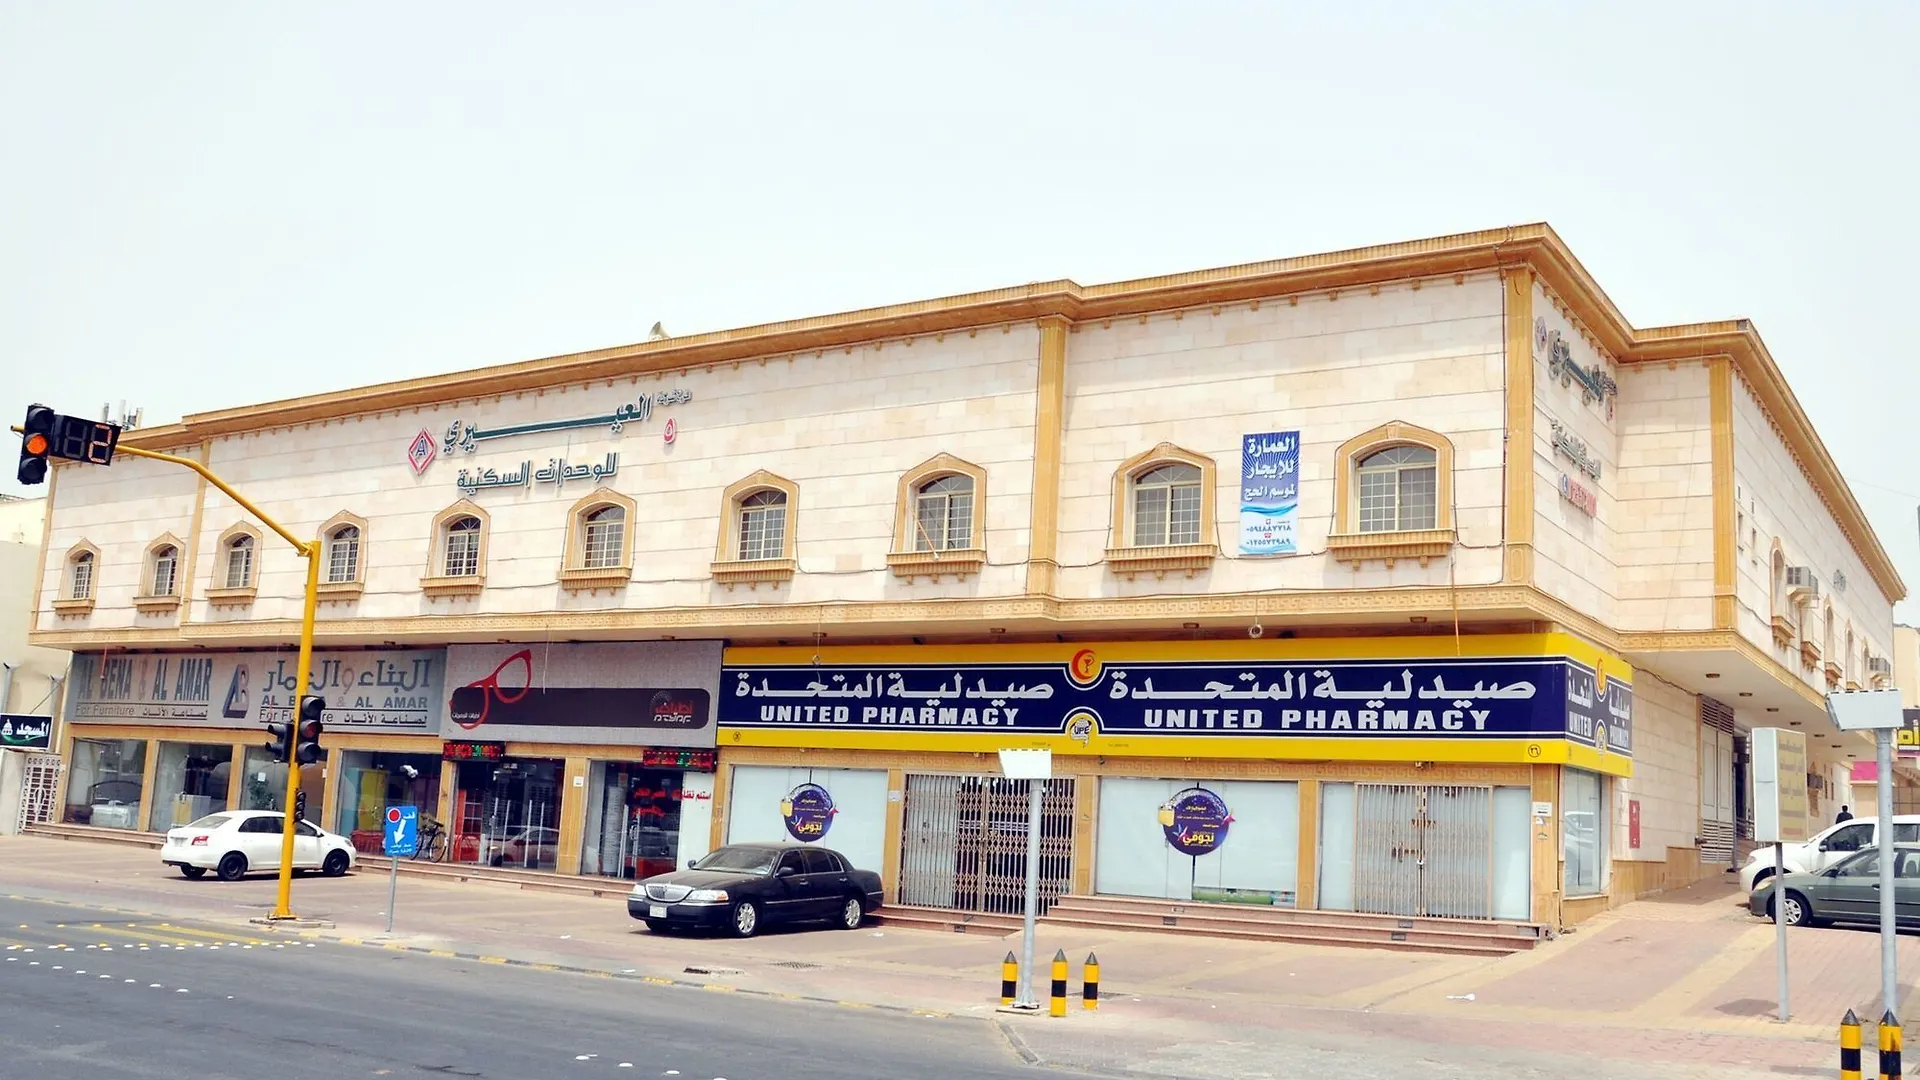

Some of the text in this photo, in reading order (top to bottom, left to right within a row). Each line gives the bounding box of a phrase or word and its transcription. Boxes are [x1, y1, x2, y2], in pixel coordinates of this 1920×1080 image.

[444, 393, 653, 455] العييري
[1248, 436, 1295, 457] العمارة
[457, 452, 617, 496] للوحدات السكنية
[1246, 459, 1295, 479] للإيجار
[1244, 484, 1296, 500] لموسم الحج
[151, 658, 168, 700] AL
[174, 658, 213, 701] AMAR
[735, 671, 1055, 707] صيدلية المتحدة
[1109, 668, 1537, 708] صيدلية المتحدة
[76, 704, 135, 716] For Furniture
[262, 696, 278, 706] AL
[355, 697, 373, 708] AL
[383, 697, 428, 708] AMAR
[259, 708, 277, 721] For
[380, 713, 427, 725] لصناعة
[760, 705, 1020, 726] UNITED PHARMACY
[1144, 709, 1491, 730] UNITED PHARMACY
[1569, 711, 1592, 738] UNITED
[16, 721, 50, 739] المسجد
[1182, 832, 1214, 847] نجومي
